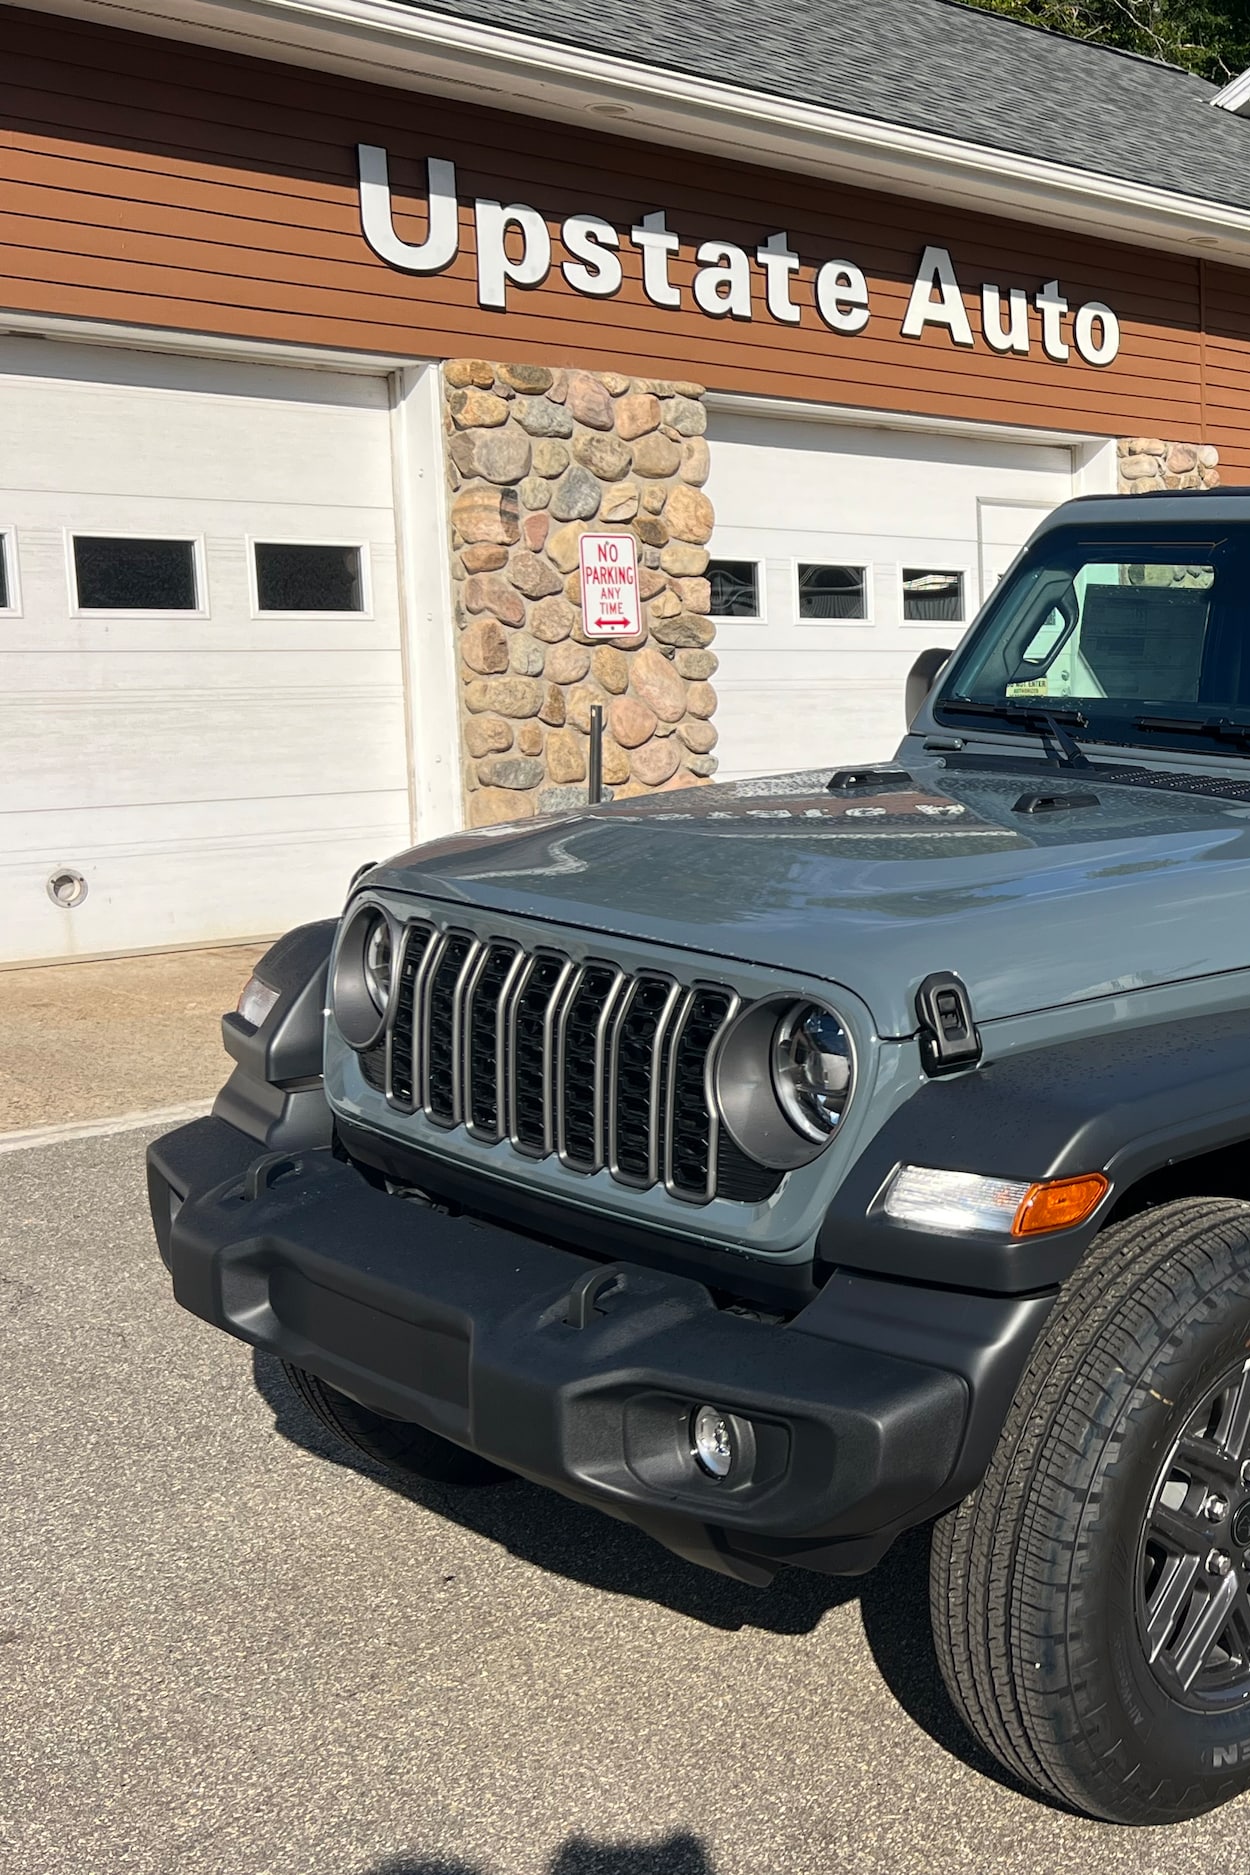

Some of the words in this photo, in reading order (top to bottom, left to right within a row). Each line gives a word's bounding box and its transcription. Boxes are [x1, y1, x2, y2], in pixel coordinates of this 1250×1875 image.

[357, 143, 871, 336] Upstate
[901, 245, 1122, 368] Auto
[597, 543, 619, 563] NO
[585, 566, 634, 585] PARKING
[600, 587, 621, 600] ANY
[599, 602, 624, 615] TIME
